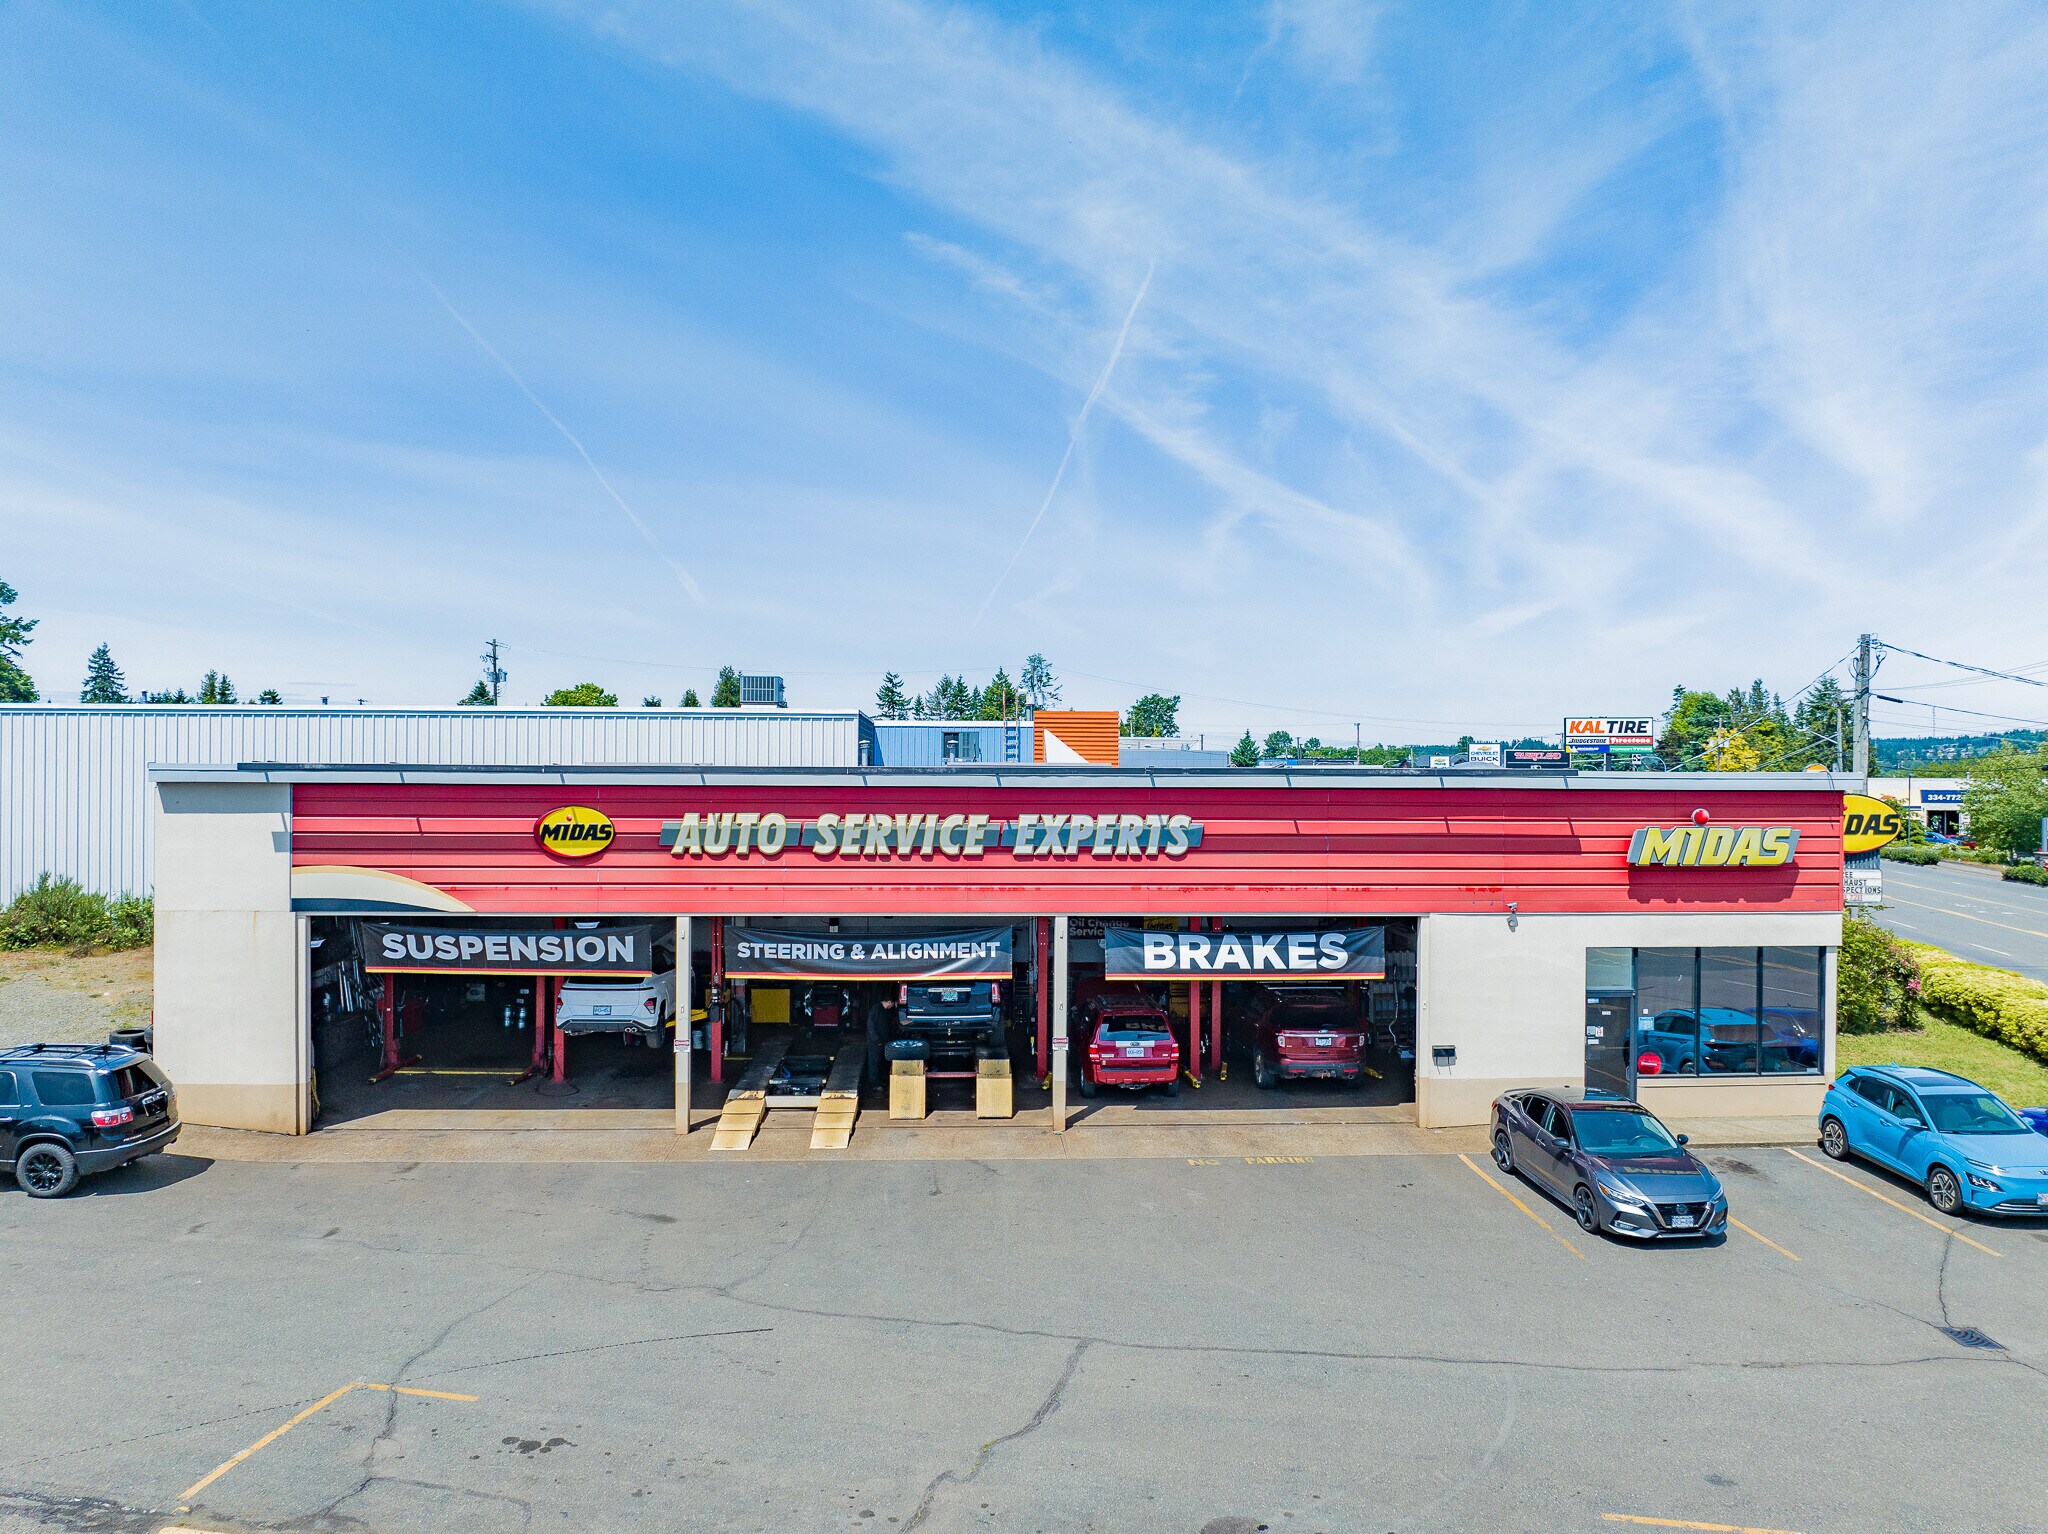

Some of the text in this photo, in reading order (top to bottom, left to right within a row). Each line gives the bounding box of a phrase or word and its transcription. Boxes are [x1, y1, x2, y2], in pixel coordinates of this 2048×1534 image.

[1569, 720, 1649, 734] KAL TIRE
[1927, 793, 1965, 801] 334-772
[540, 822, 613, 842] MIDAS
[671, 812, 1192, 856] AUTO SERVICE EXPERTS
[1843, 813, 1900, 836] DAS
[1636, 825, 1794, 867] MIDAS
[1842, 886, 1881, 894] SPECTIONS
[1069, 918, 1085, 927] Oil
[1069, 927, 1106, 937] Servic
[1149, 922, 1174, 930] MIDAS
[382, 933, 634, 963] SUSPENSION
[737, 941, 1000, 960] STEERING & ALIGNMENT
[1143, 933, 1349, 969] BRAKES
